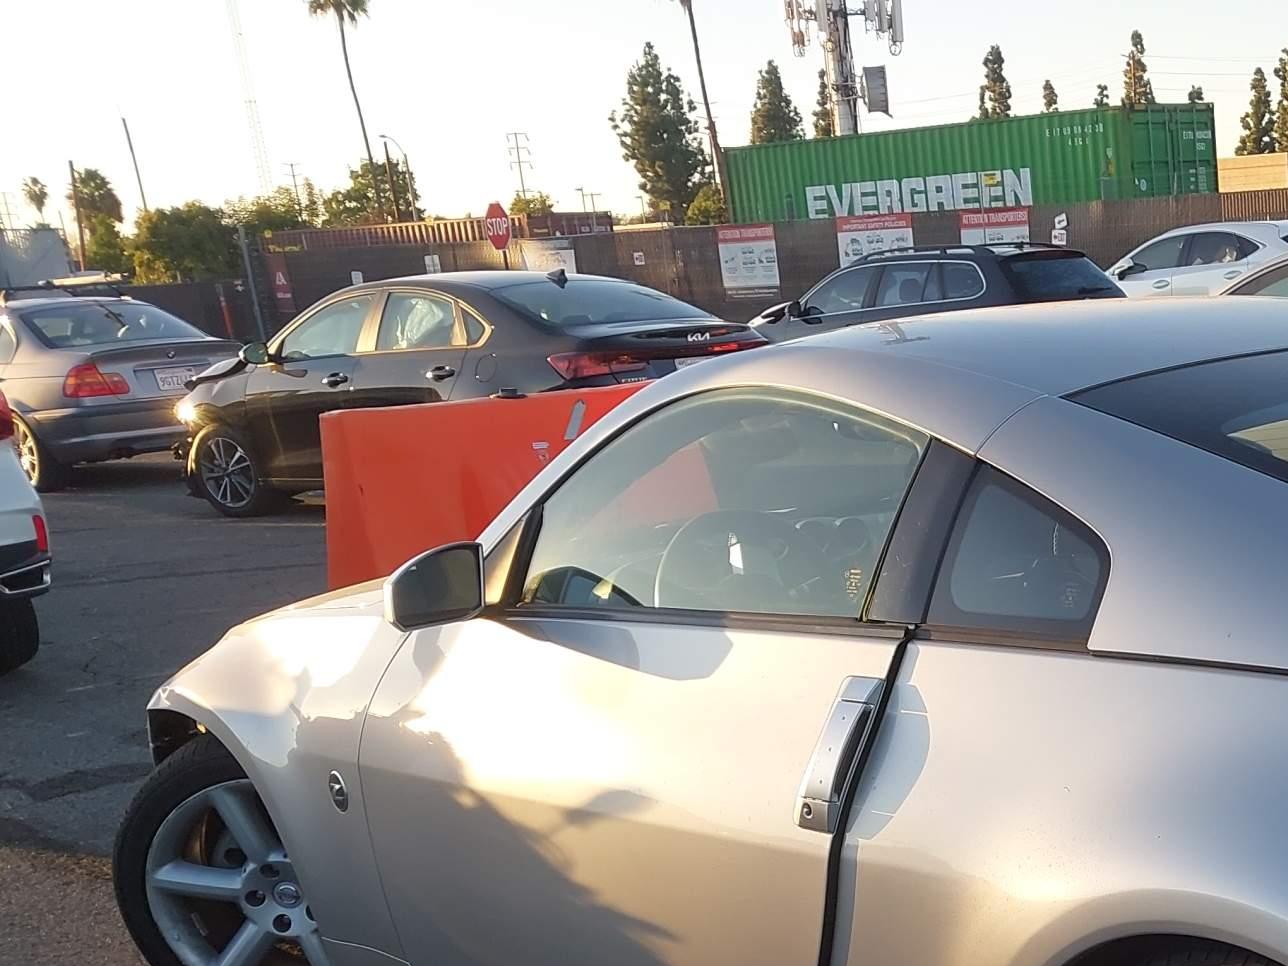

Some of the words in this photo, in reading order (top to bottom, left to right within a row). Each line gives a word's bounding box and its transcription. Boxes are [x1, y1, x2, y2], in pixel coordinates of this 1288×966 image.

[805, 168, 1033, 220] EVERGREEN
[486, 217, 508, 236] STOP
[687, 332, 710, 342] KIA
